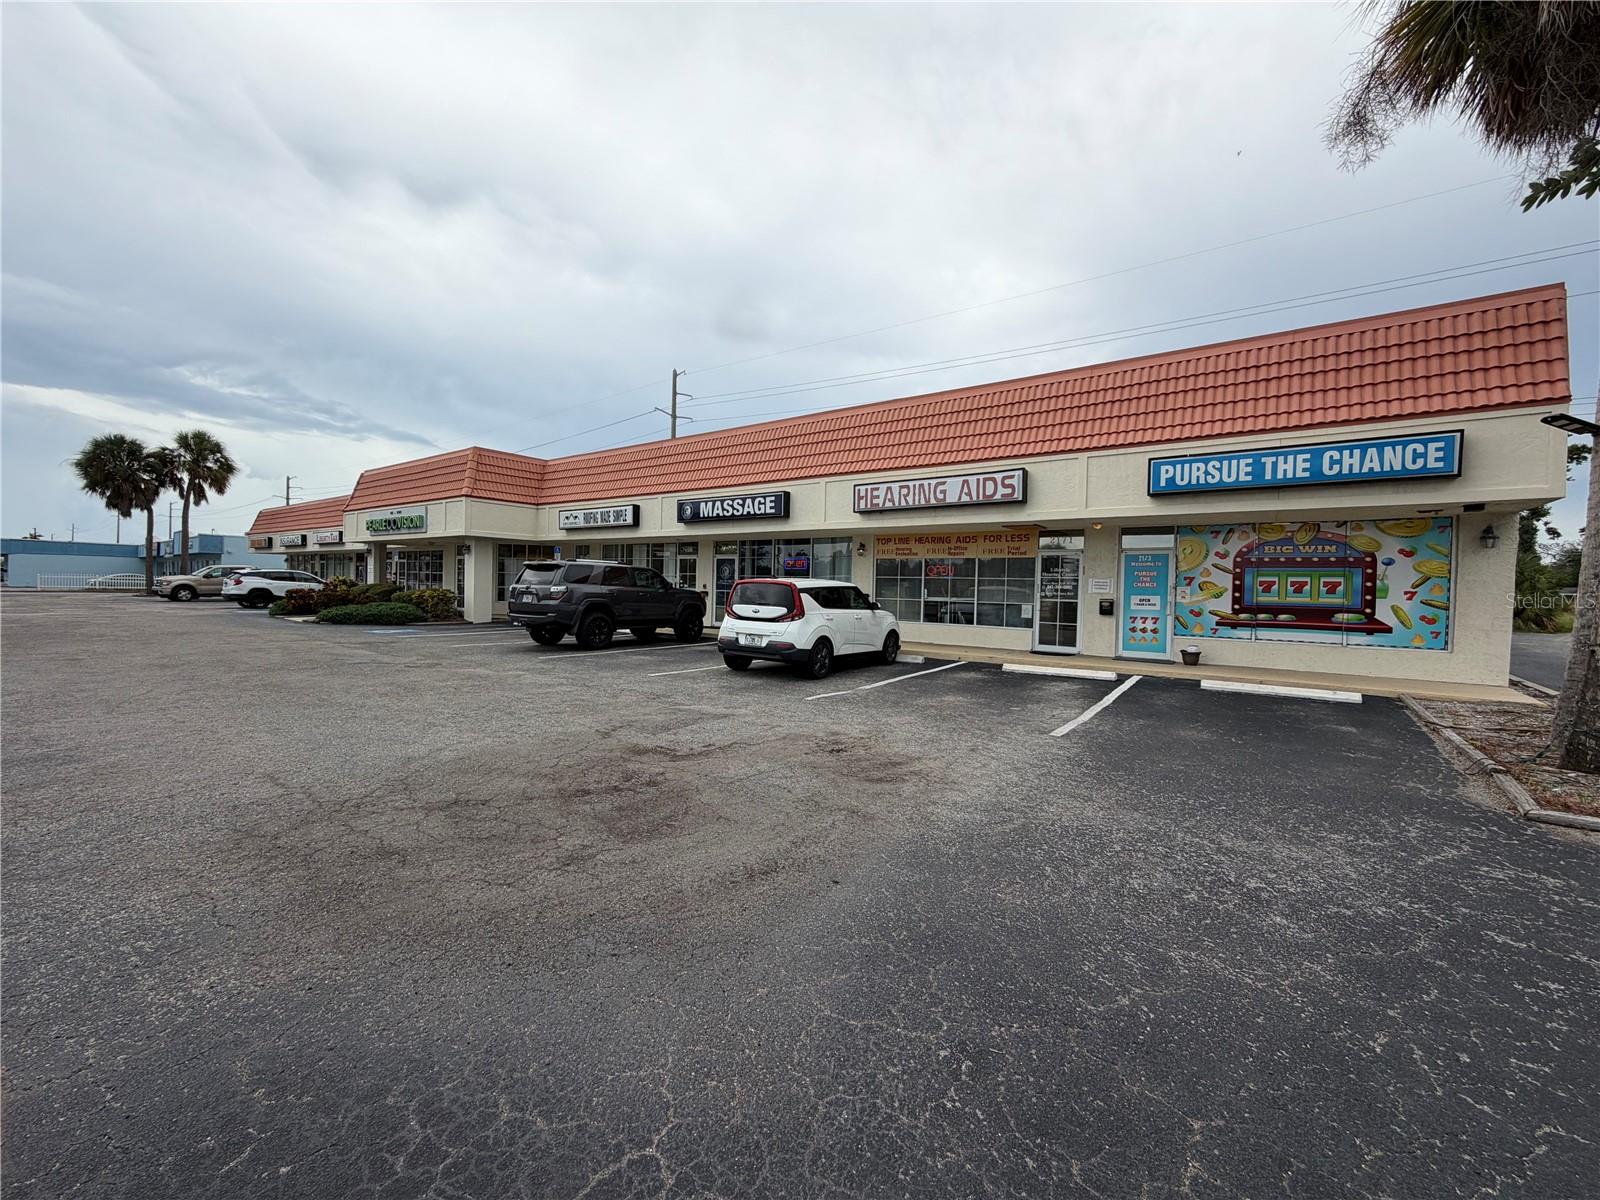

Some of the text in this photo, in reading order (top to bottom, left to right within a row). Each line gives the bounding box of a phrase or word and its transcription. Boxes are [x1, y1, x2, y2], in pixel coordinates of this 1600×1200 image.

[1160, 442, 1445, 487] PURSUE THE CHANCE
[856, 475, 1016, 509] HEARING AIDS
[700, 496, 775, 518] MASSAGE
[365, 515, 424, 531] PEARLE VISION
[876, 533, 1031, 545] TOP LINE HEARING AIDS FOR LESS
[1263, 545, 1337, 553] BIG WIN
[926, 565, 955, 576] OPEN
[1258, 580, 1342, 595] 7 7 7
